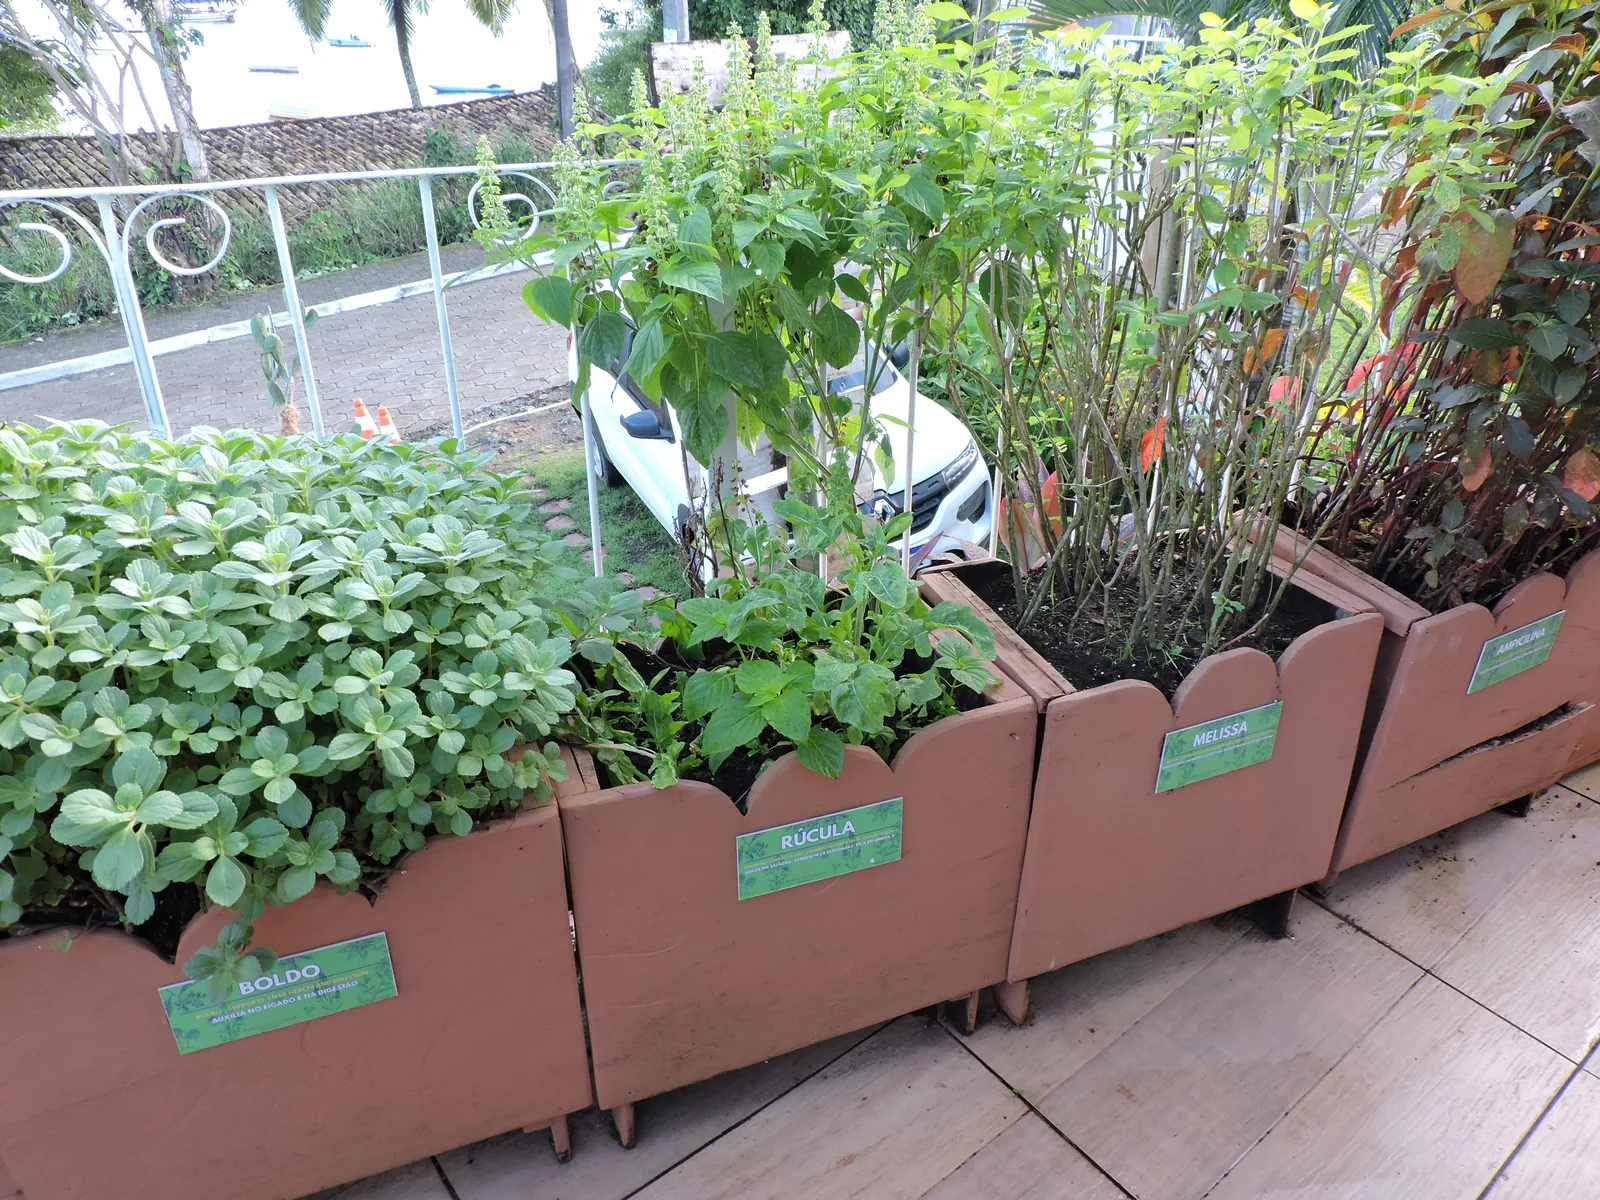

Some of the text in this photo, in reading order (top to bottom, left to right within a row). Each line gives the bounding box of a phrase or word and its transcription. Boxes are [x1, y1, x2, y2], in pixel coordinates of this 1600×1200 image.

[1496, 628, 1546, 655] AMPICILINA
[1193, 720, 1248, 747] MELISSA
[781, 820, 856, 850] RÚCULA
[238, 963, 321, 996] BOLDO
[211, 1010, 247, 1024] AUXILIA
[247, 1006, 262, 1015] NO
[303, 991, 318, 1000] NA
[317, 979, 359, 996] DIGESTÃO
